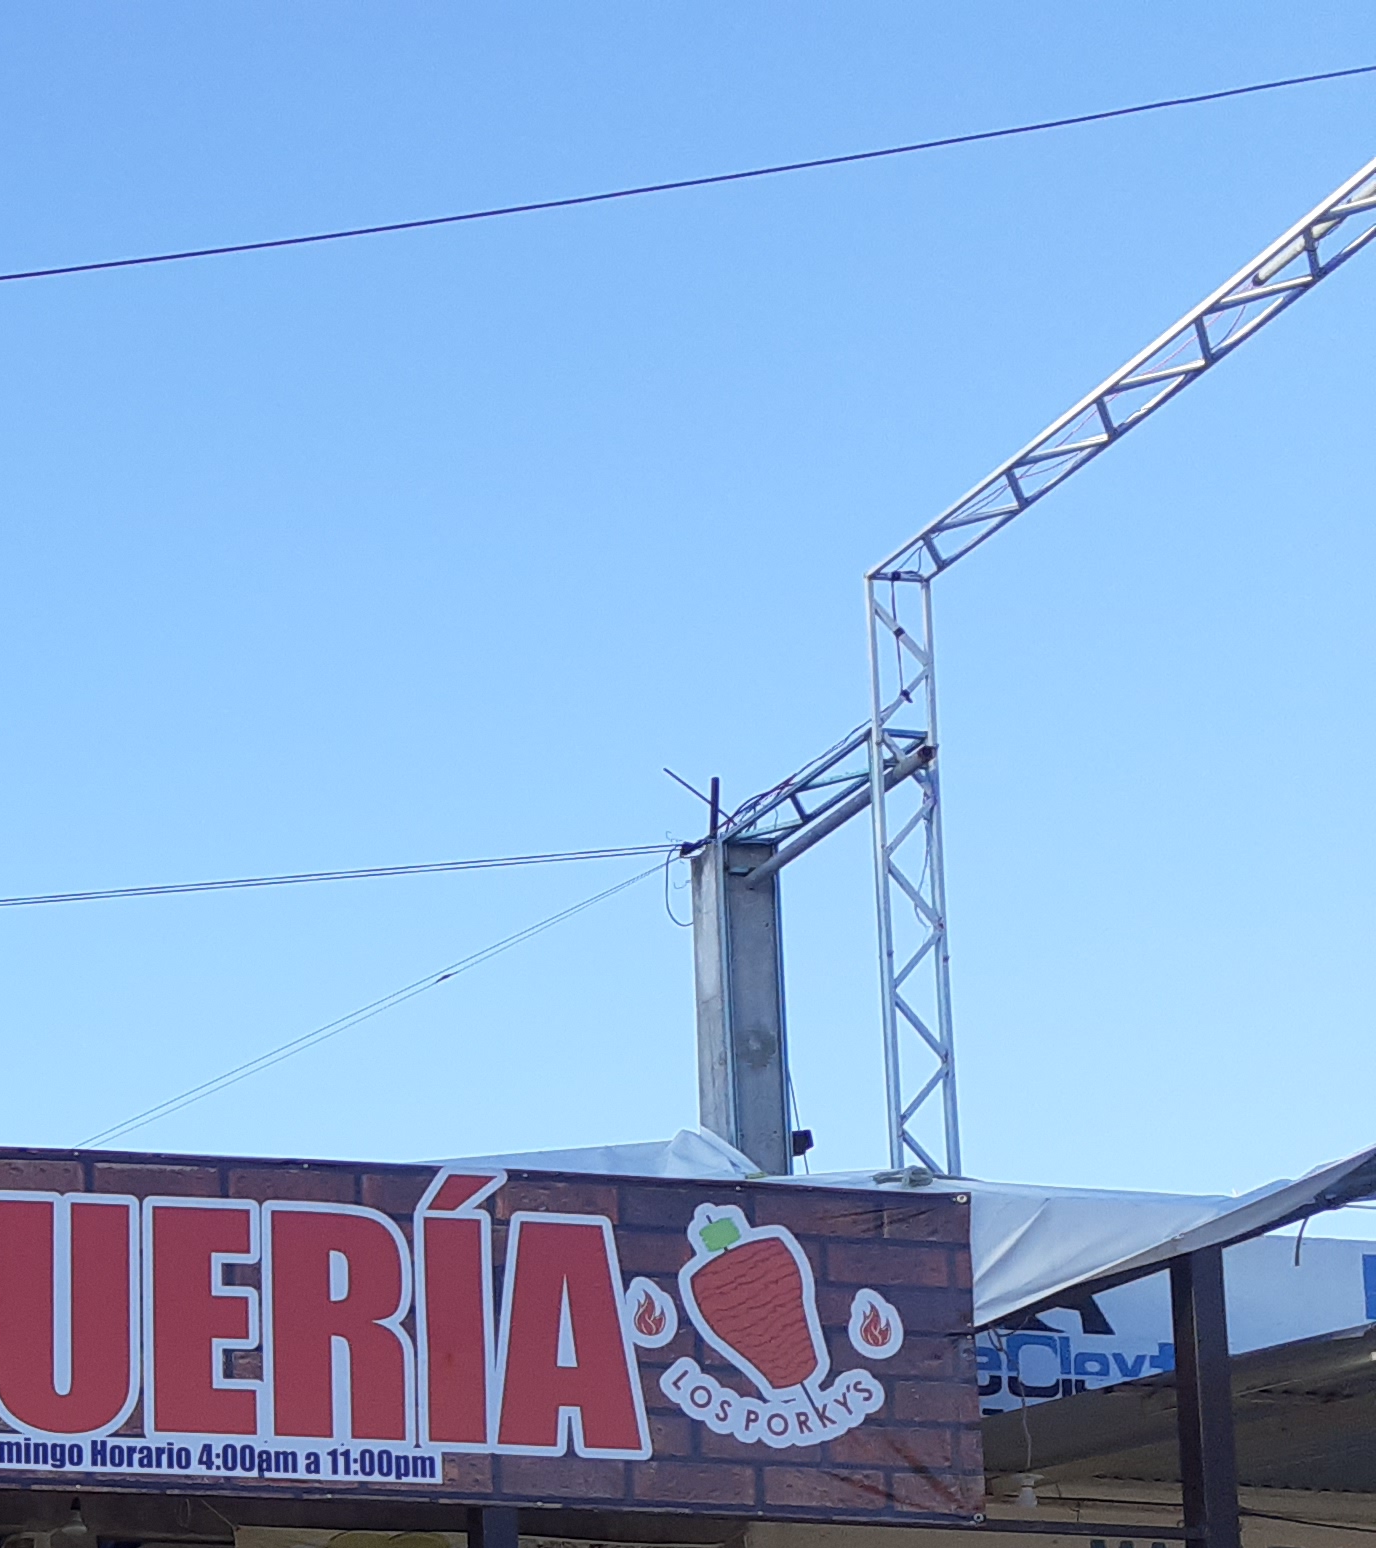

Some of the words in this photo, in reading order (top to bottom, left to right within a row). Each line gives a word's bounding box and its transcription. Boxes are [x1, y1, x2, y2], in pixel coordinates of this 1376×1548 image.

[672, 1369, 732, 1422] LOS
[745, 1381, 873, 1436] PORKY'S
[90, 1439, 191, 1470] Horario
[304, 1451, 321, 1475] a
[327, 1448, 436, 1480] 11:00pm
